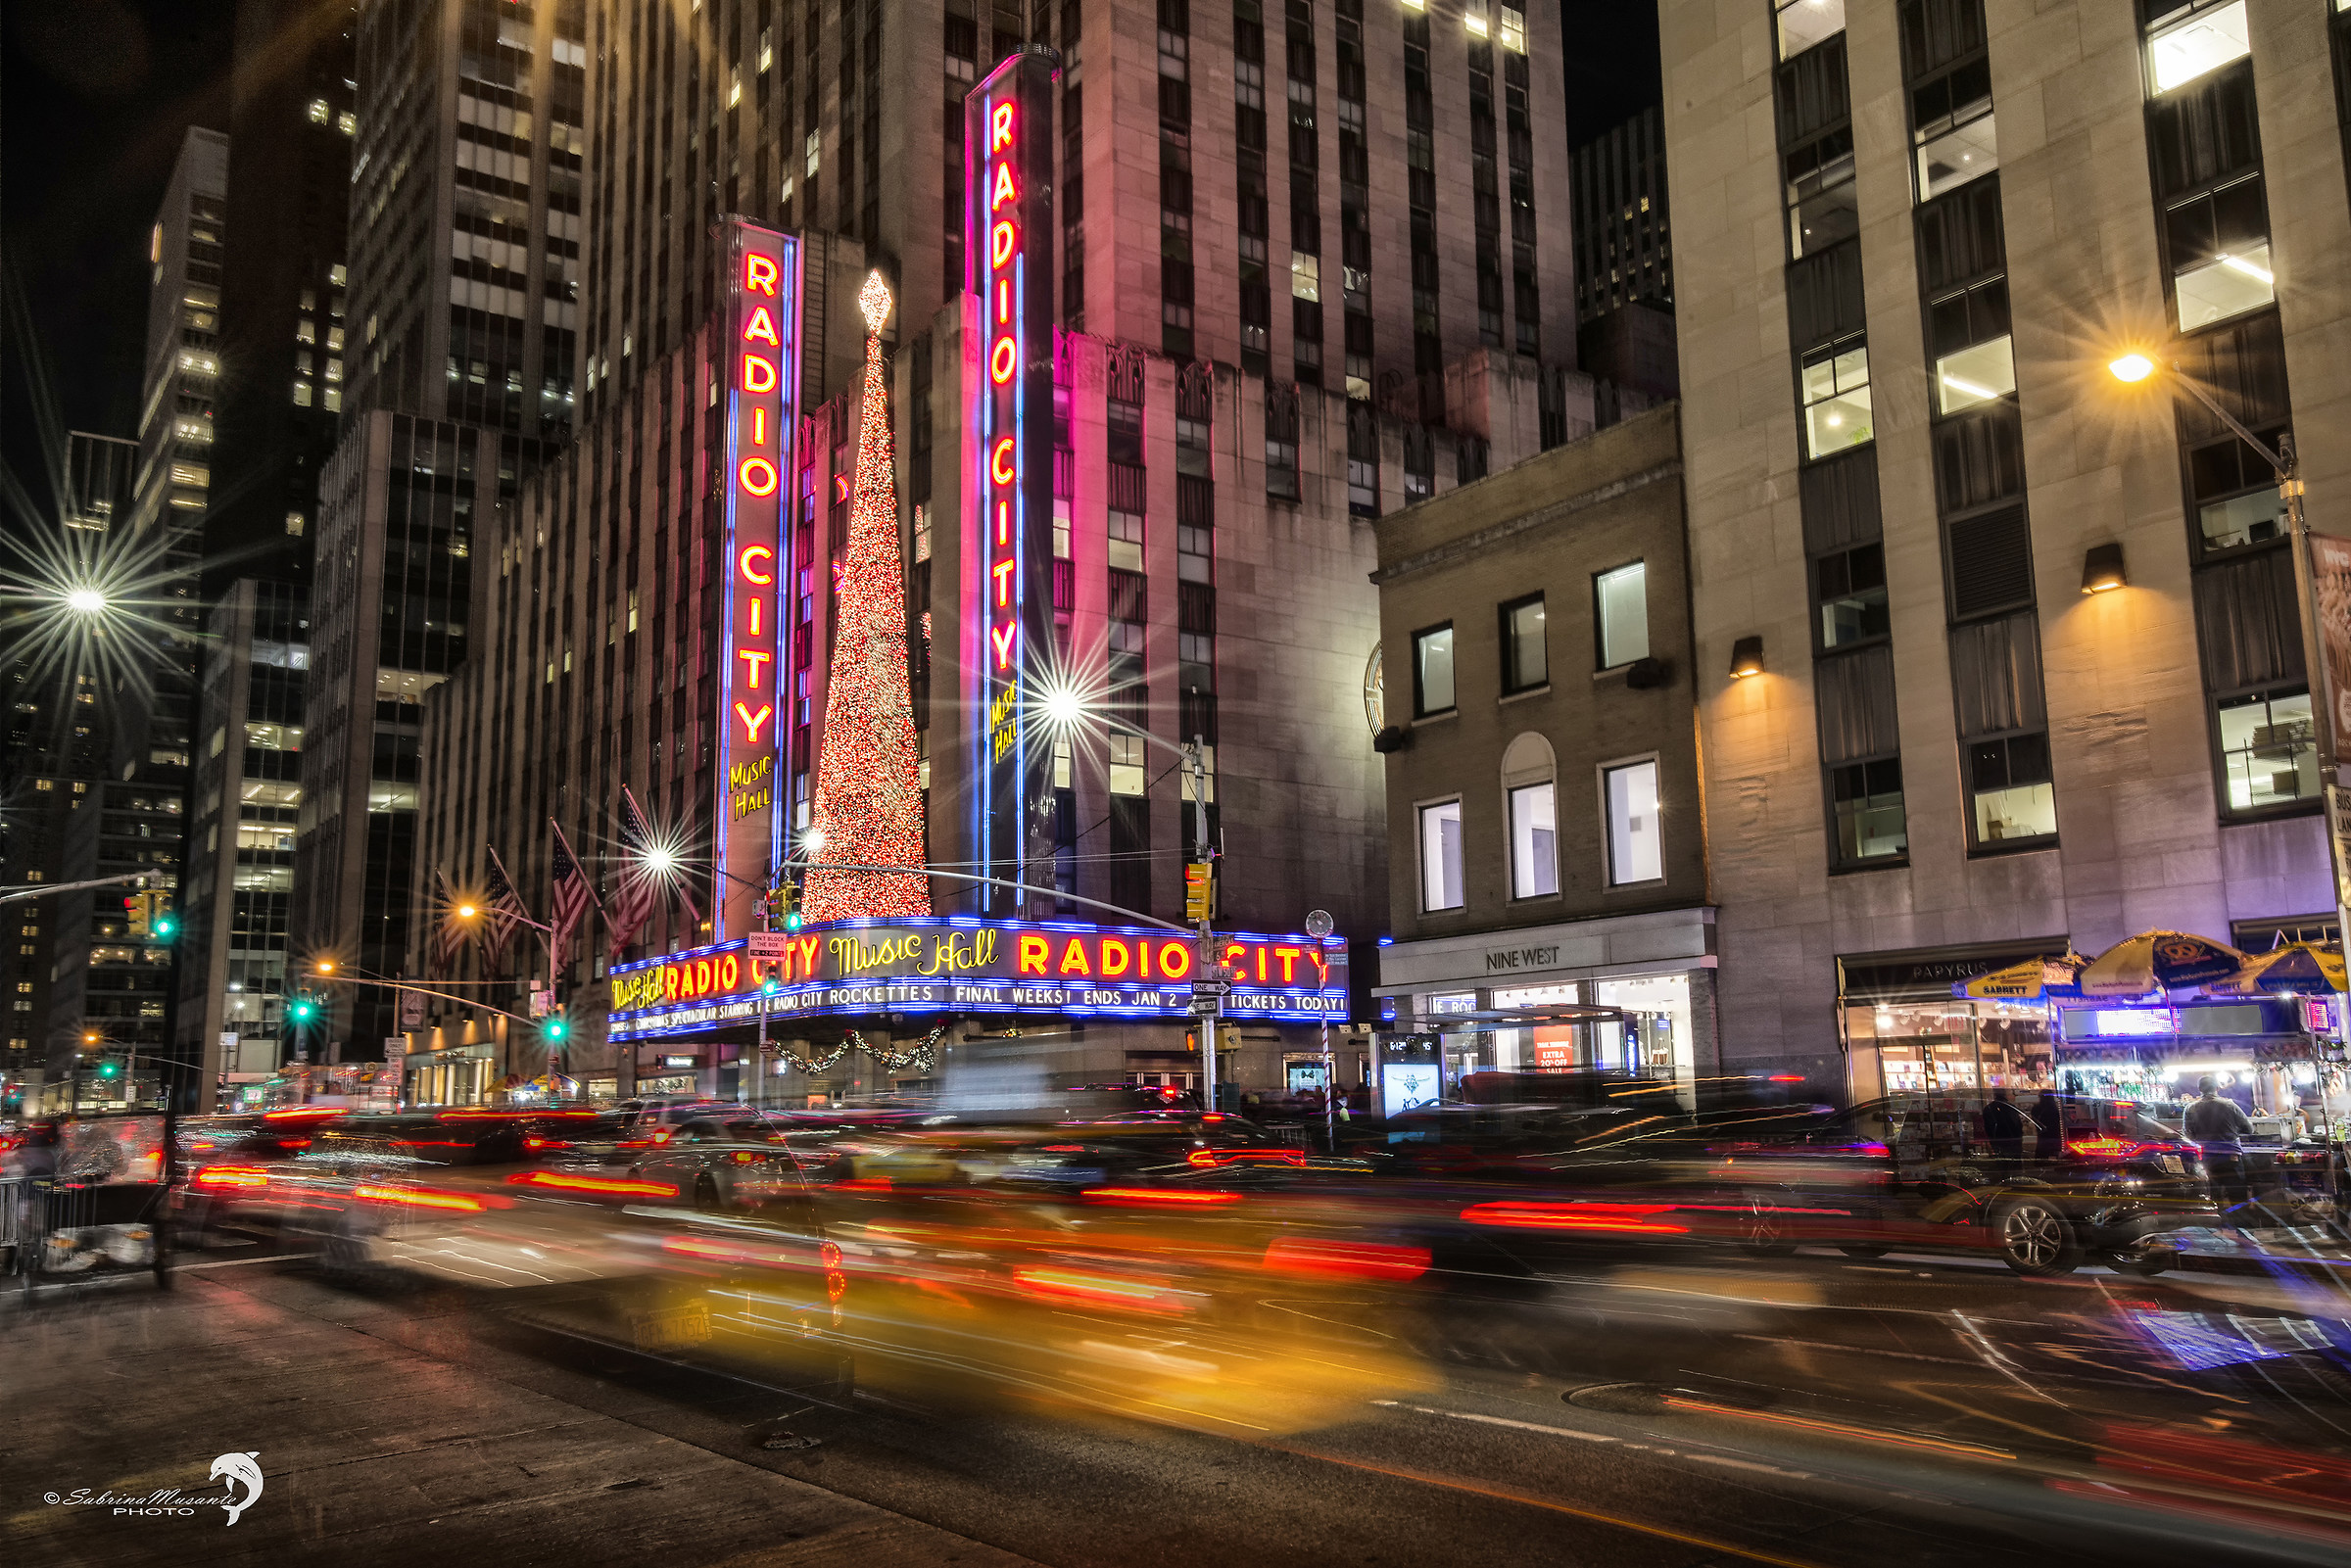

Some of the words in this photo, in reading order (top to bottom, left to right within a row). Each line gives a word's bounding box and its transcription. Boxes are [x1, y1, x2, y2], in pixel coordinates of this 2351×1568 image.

[991, 103, 1016, 384] RADIO
[740, 254, 779, 496] RADIO
[991, 439, 1016, 669] CITY
[735, 546, 773, 742] CITY
[666, 954, 738, 1000] RADIO
[751, 936, 819, 985] CTY
[829, 934, 922, 975] Music
[916, 928, 999, 975] Hall
[1020, 935, 1189, 978] RADIO
[1486, 950, 1519, 971] NINE
[1521, 945, 1559, 967] WEST
[1913, 962, 1989, 978] PAPYRUS
[719, 1001, 753, 1019] STARRING
[757, 999, 770, 1013] TE
[774, 994, 798, 1011] RADIO
[801, 991, 823, 1007] CITY
[830, 986, 933, 1004] ROCKETTES
[956, 987, 1002, 1003] FINAL
[1013, 988, 1071, 1004] WEEKS!
[1083, 990, 1122, 1005] ENDS
[1131, 991, 1160, 1006] JAN
[1169, 993, 1177, 1007] 2
[1230, 995, 1286, 1010] TICKETS
[1295, 996, 1344, 1011] TODAY!
[1542, 1051, 1565, 1060] EXTRA
